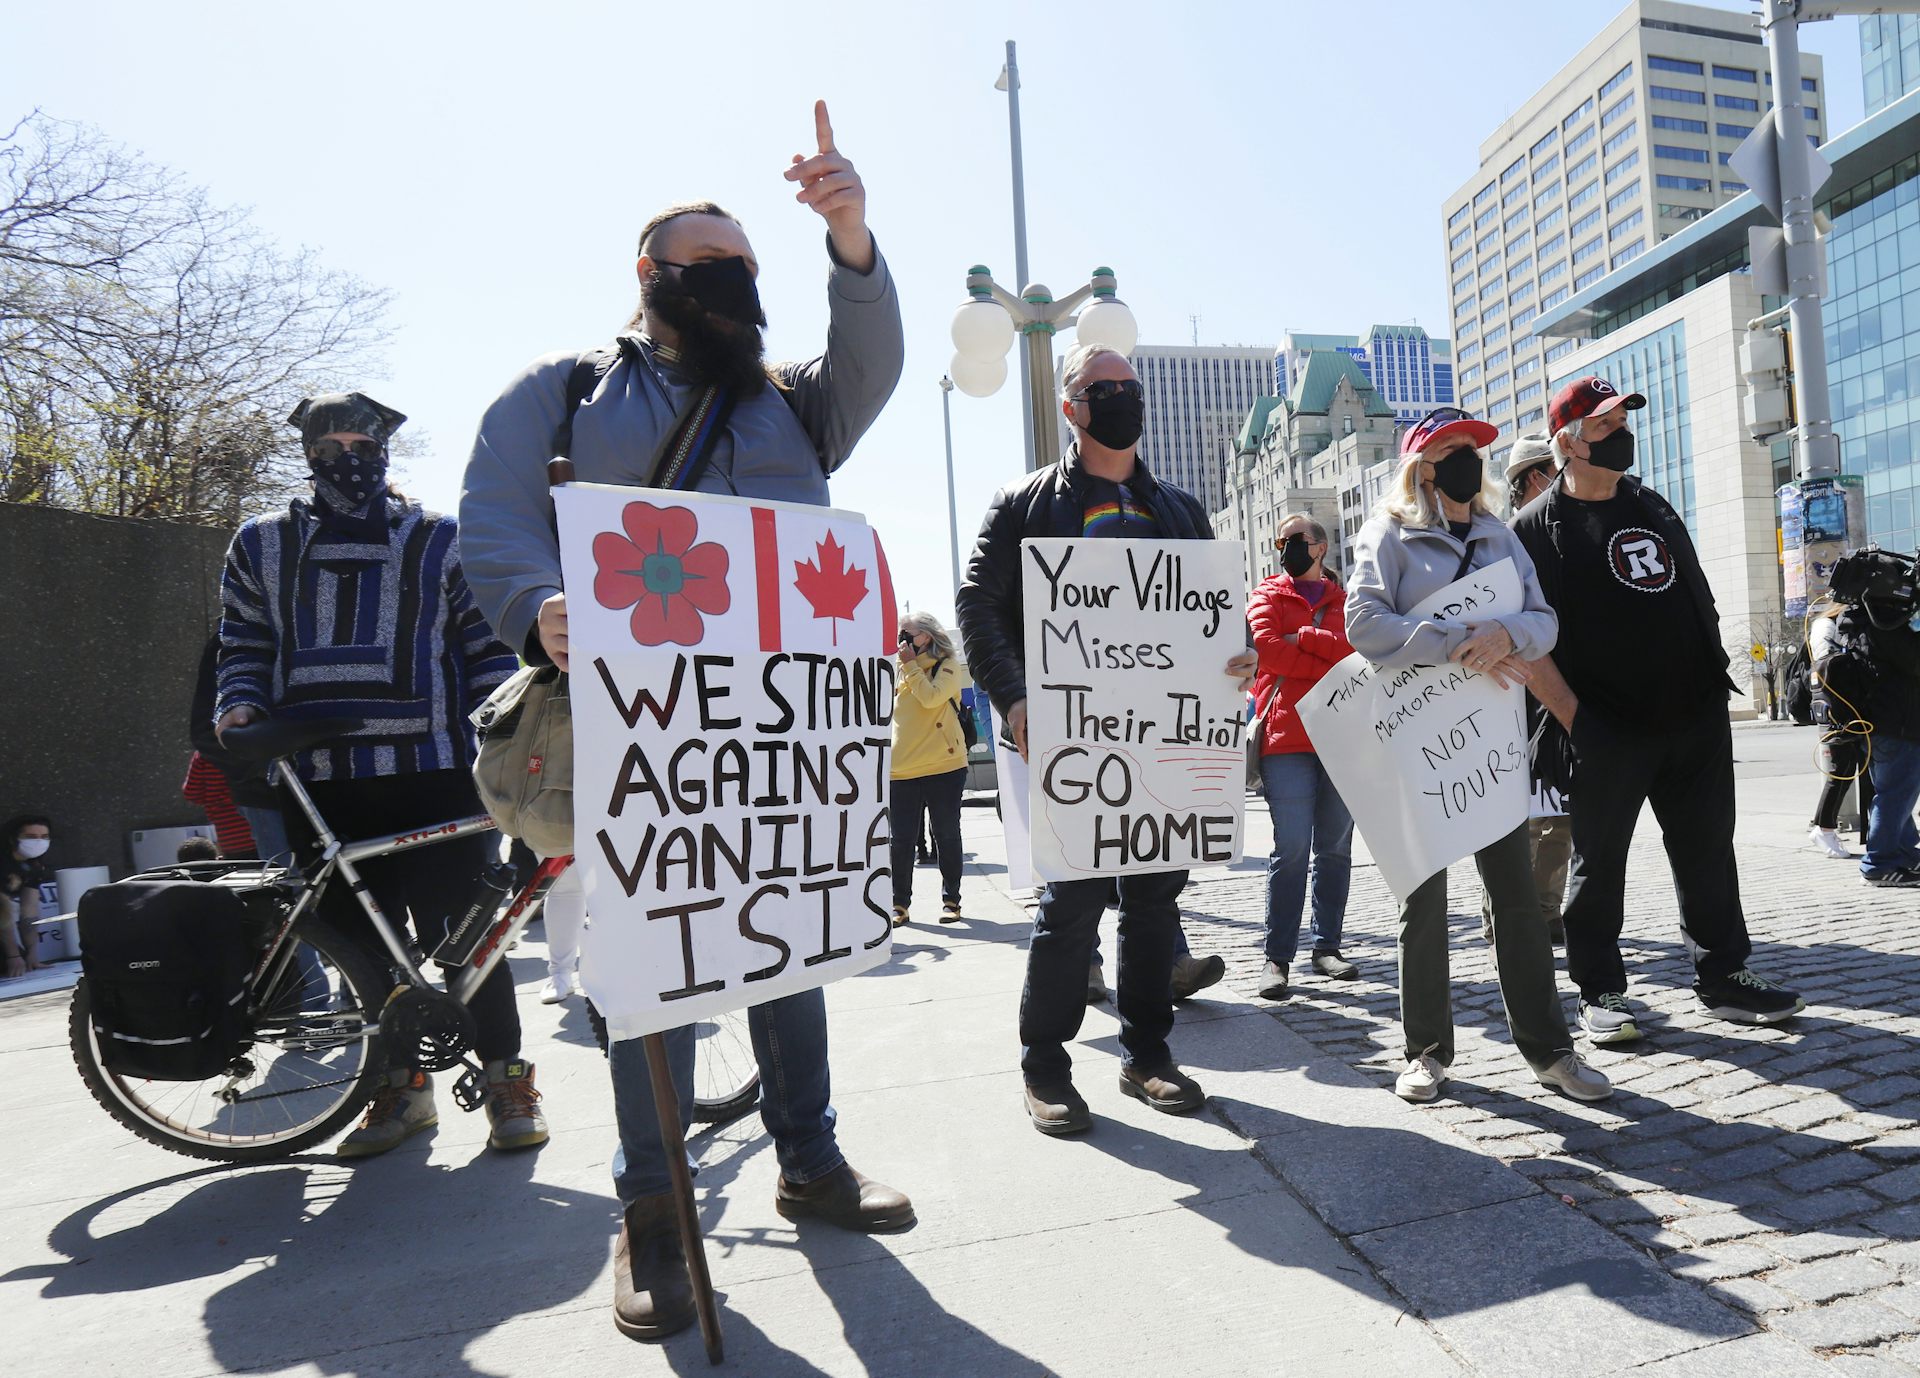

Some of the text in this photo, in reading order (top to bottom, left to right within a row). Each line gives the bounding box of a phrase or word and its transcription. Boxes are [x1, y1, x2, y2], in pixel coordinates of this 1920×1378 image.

[1028, 545, 1232, 638] Your Village
[1621, 539, 1665, 580] R
[1433, 584, 1496, 621] ADA'S
[1042, 619, 1174, 674] Misses
[593, 653, 894, 733] WE STAND
[1041, 684, 1246, 748] Their Idiot
[1375, 668, 1482, 743] MEMORIAL
[1422, 709, 1482, 770] NOT
[1423, 710, 1526, 818] YOURS!
[607, 738, 891, 817] AGAINST
[1042, 747, 1131, 807] GO
[596, 807, 891, 897] VANILLA
[1093, 813, 1233, 869] HOME
[448, 903, 482, 945] lululemon
[646, 867, 892, 1001] ISIS
